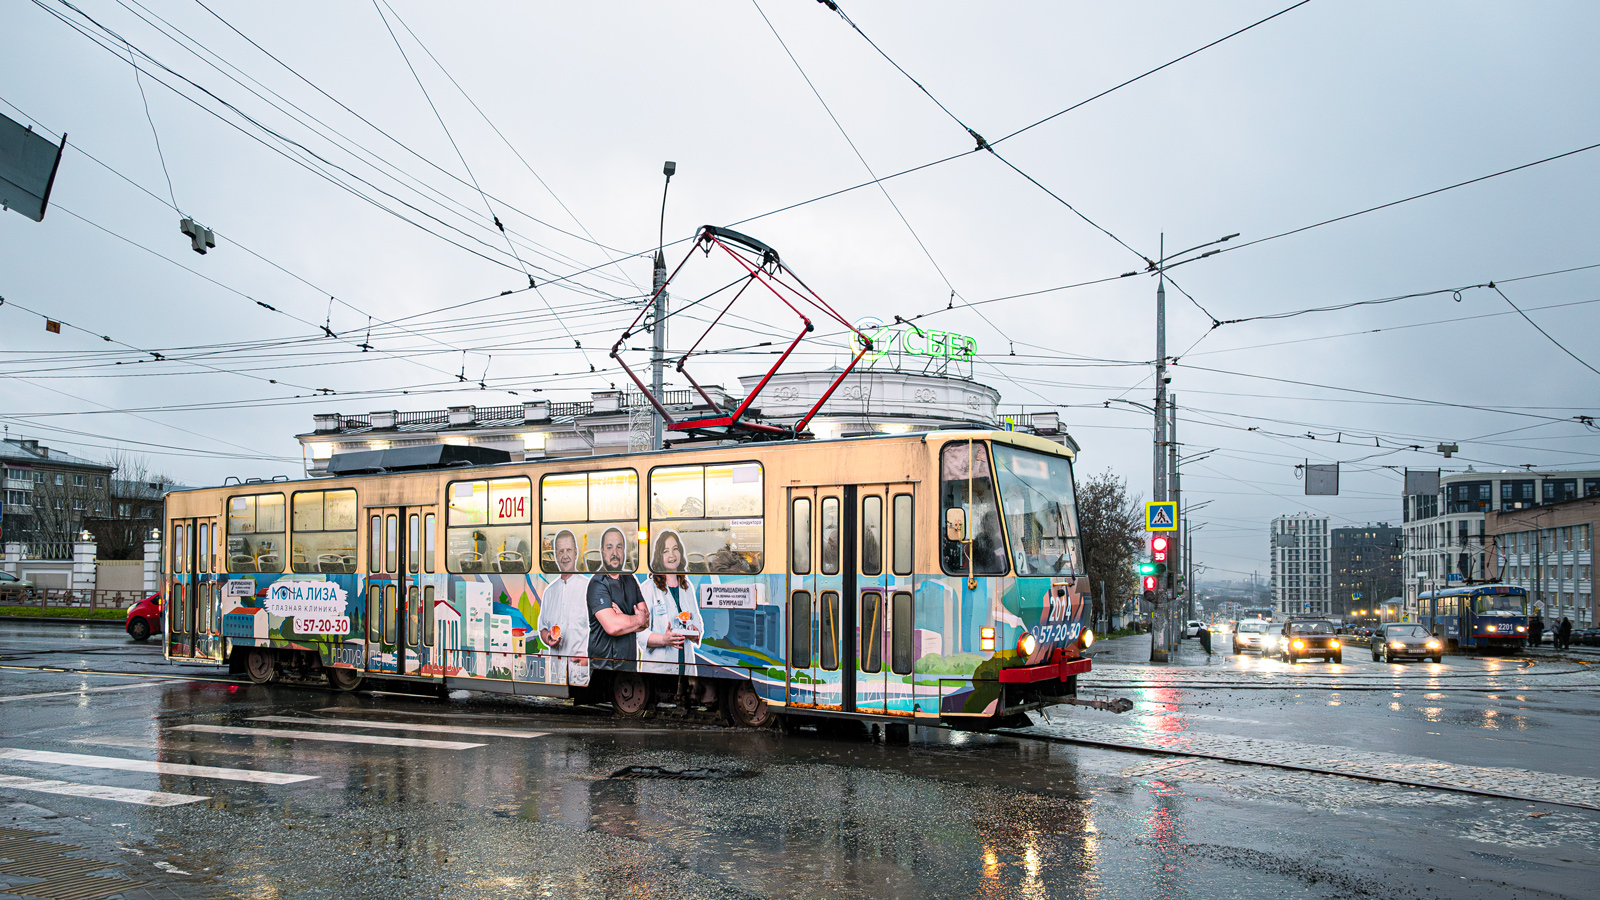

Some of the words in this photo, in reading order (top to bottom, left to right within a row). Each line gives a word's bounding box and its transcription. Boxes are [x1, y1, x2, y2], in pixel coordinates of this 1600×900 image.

[902, 328, 977, 362] СБЕР
[498, 496, 525, 518] 2014
[271, 586, 303, 601] МОНА
[305, 587, 337, 601] ЛИЗА
[271, 604, 302, 612] ГЛАЗНАЯ
[304, 605, 337, 613] КЛИНИКА
[1048, 596, 1072, 622] 2014
[303, 619, 348, 632] 57-20-30
[1038, 622, 1081, 643] 57-20-30
[1498, 623, 1513, 631] 2201
